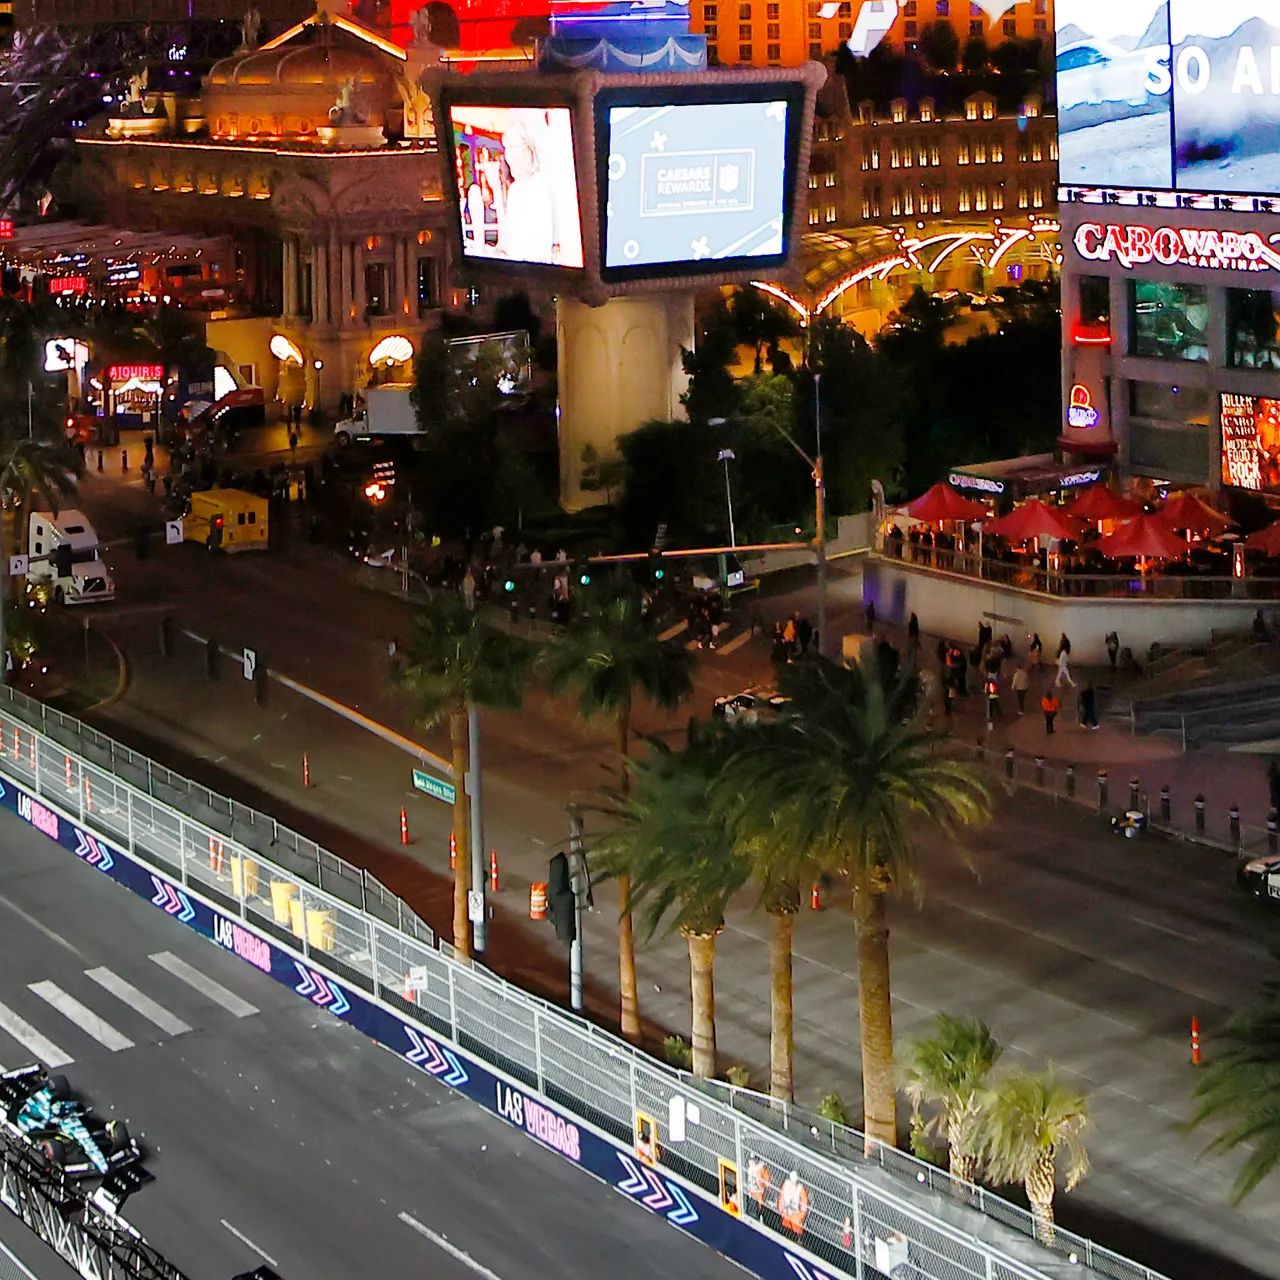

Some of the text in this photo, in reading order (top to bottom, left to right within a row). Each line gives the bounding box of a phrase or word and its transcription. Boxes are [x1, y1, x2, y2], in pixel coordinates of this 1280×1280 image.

[657, 166, 711, 181] CAESARS
[657, 180, 712, 195] REWARDS
[1074, 223, 1182, 268] CABO
[1188, 256, 1259, 270] CANTINA
[1229, 461, 1262, 479] ROCK
[214, 913, 233, 949] LAS
[496, 1080, 581, 1161] LAS VEGAS
